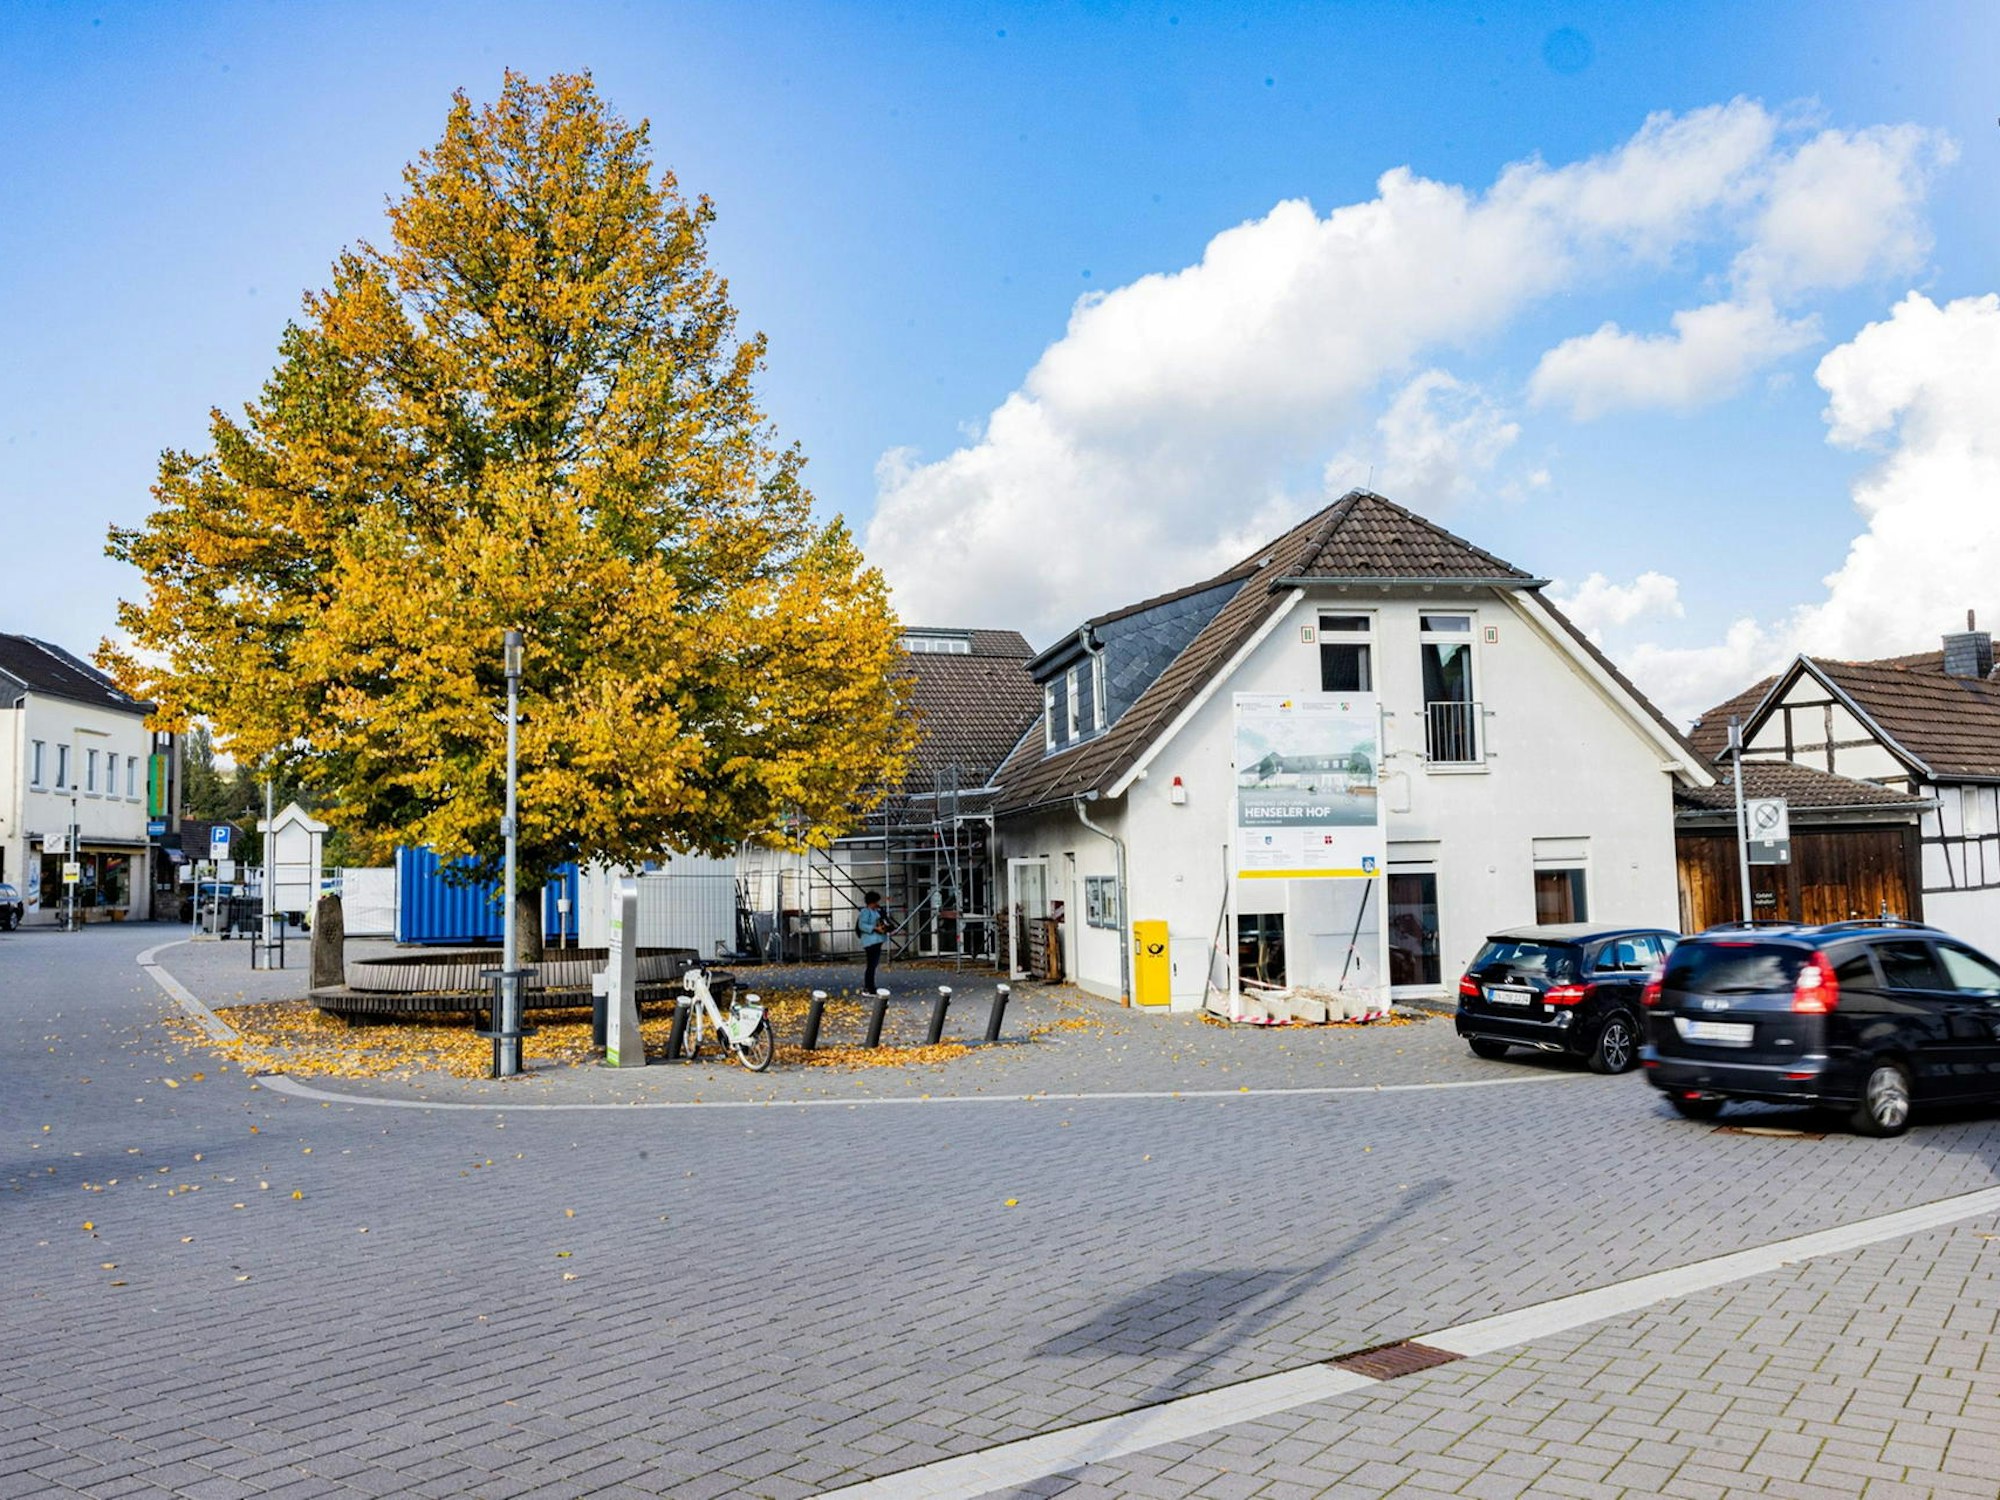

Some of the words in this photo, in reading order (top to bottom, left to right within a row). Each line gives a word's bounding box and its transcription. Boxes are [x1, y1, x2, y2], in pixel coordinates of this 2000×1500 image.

[1245, 807, 1303, 817] HENSELER
[1306, 807, 1331, 817] HOF
[215, 829, 226, 842] P
